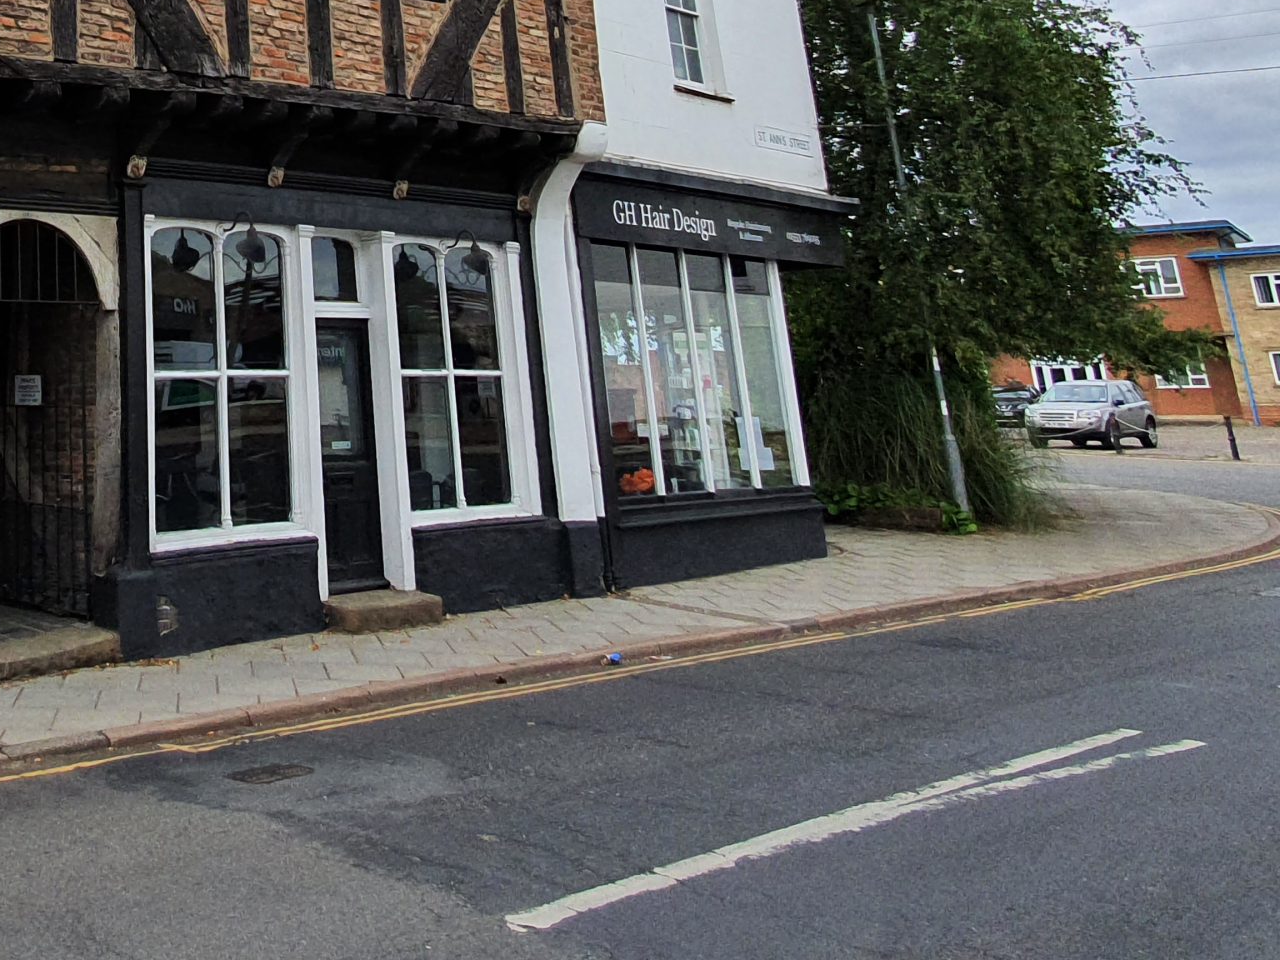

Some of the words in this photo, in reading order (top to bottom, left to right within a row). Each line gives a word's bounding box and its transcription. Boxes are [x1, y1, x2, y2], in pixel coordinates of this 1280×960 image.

[612, 199, 638, 226] GH
[640, 204, 671, 230] Hair
[672, 207, 718, 241] Design
